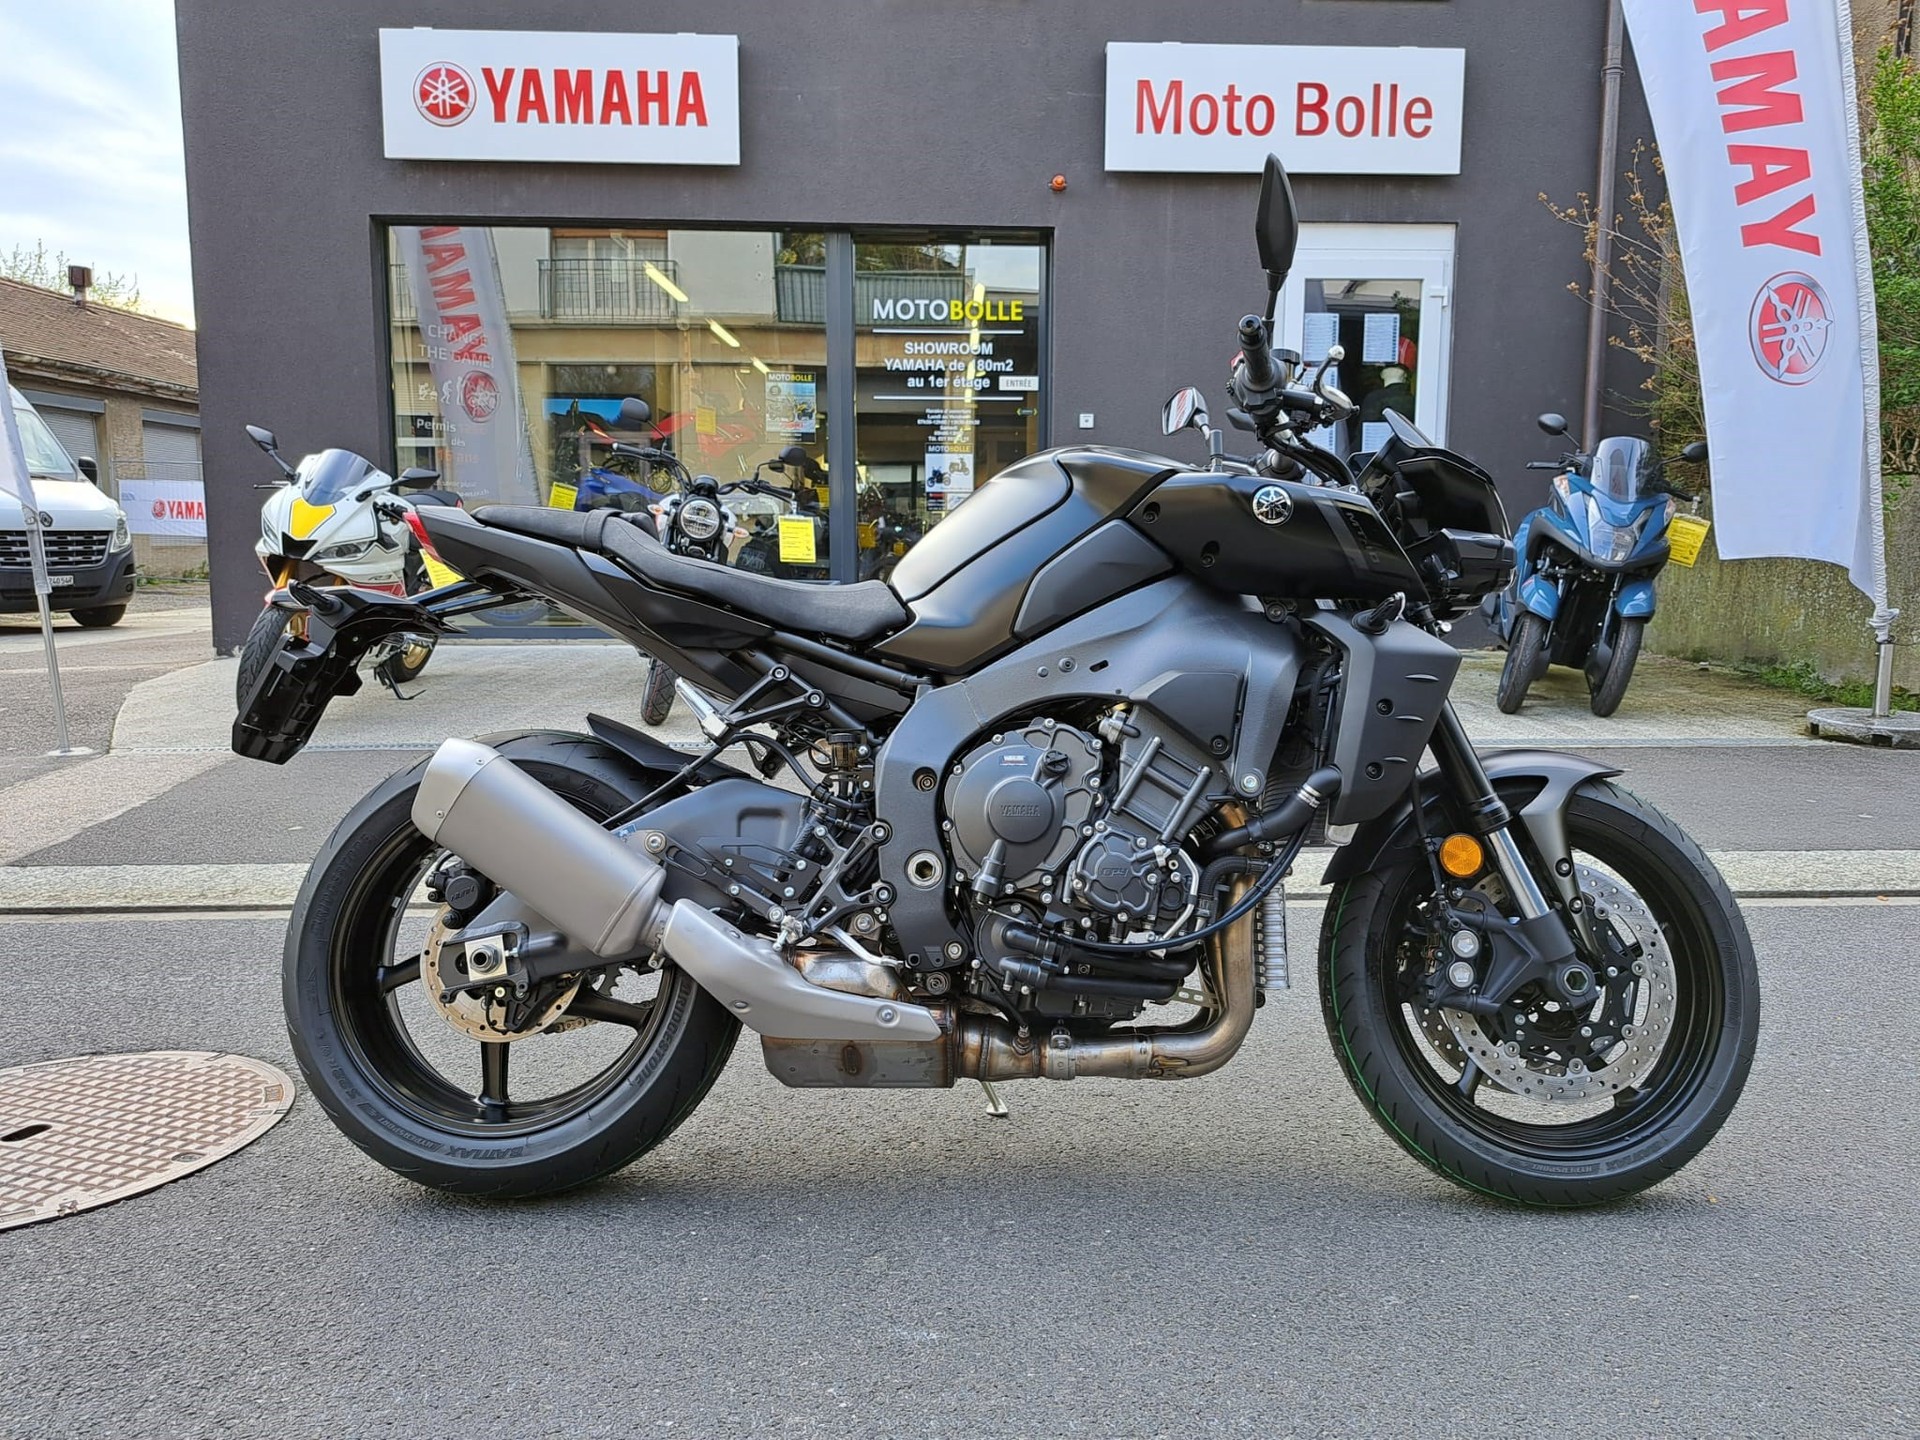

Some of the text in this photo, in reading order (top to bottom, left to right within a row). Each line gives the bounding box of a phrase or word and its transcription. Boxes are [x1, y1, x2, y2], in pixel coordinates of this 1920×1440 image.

[481, 67, 708, 127] YAMAHA
[1136, 79, 1434, 139] Moto Bolle
[872, 298, 1024, 321] MOTOBOLLE
[428, 324, 488, 347] CHANGE
[417, 343, 448, 360] THE
[904, 341, 994, 355] SHOWROOM
[884, 357, 946, 372] YAMAHA
[948, 358, 966, 372] de
[907, 375, 991, 390] au 1er étage
[1004, 379, 1033, 388] ENTRÉE
[416, 418, 457, 433] Permis
[167, 500, 205, 520] YAMA
[1001, 804, 1041, 817] YAMAHA
